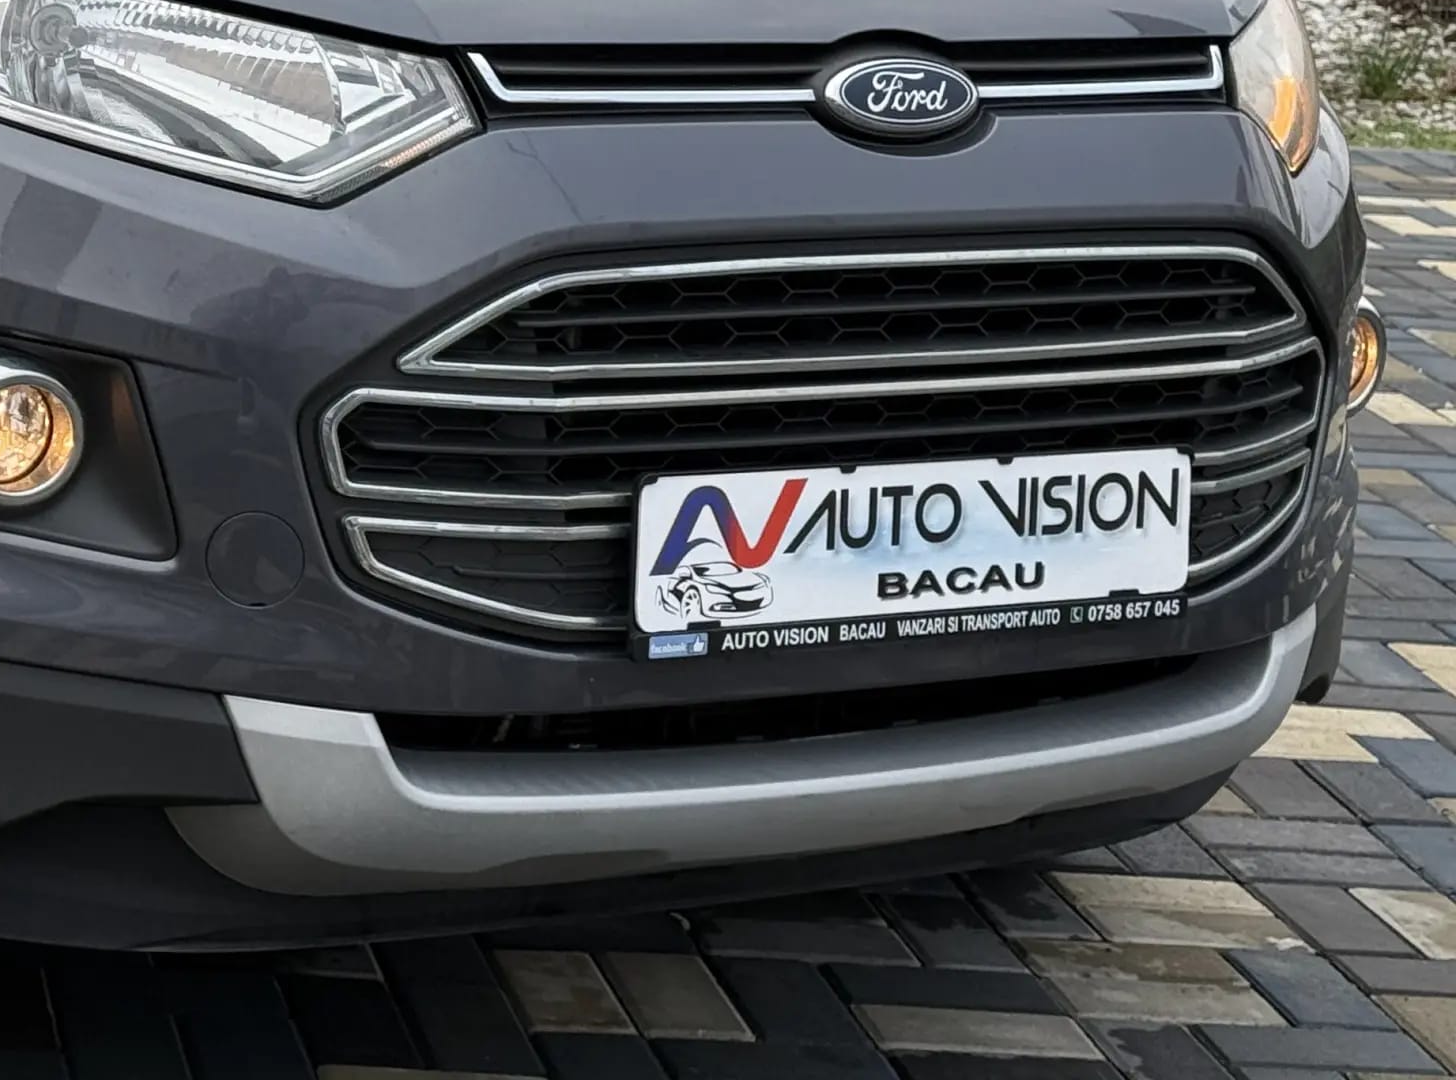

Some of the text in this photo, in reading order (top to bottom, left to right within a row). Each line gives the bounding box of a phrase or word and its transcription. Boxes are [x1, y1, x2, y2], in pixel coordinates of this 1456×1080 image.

[867, 71, 948, 113] Ford
[783, 483, 964, 555] AUTO
[978, 467, 1180, 538] VISION
[877, 561, 1045, 601] BACAU
[721, 599, 1181, 651] AUTO VISION BACAU VANZARI SI TRANSPORT AUTO 0758 657 045
